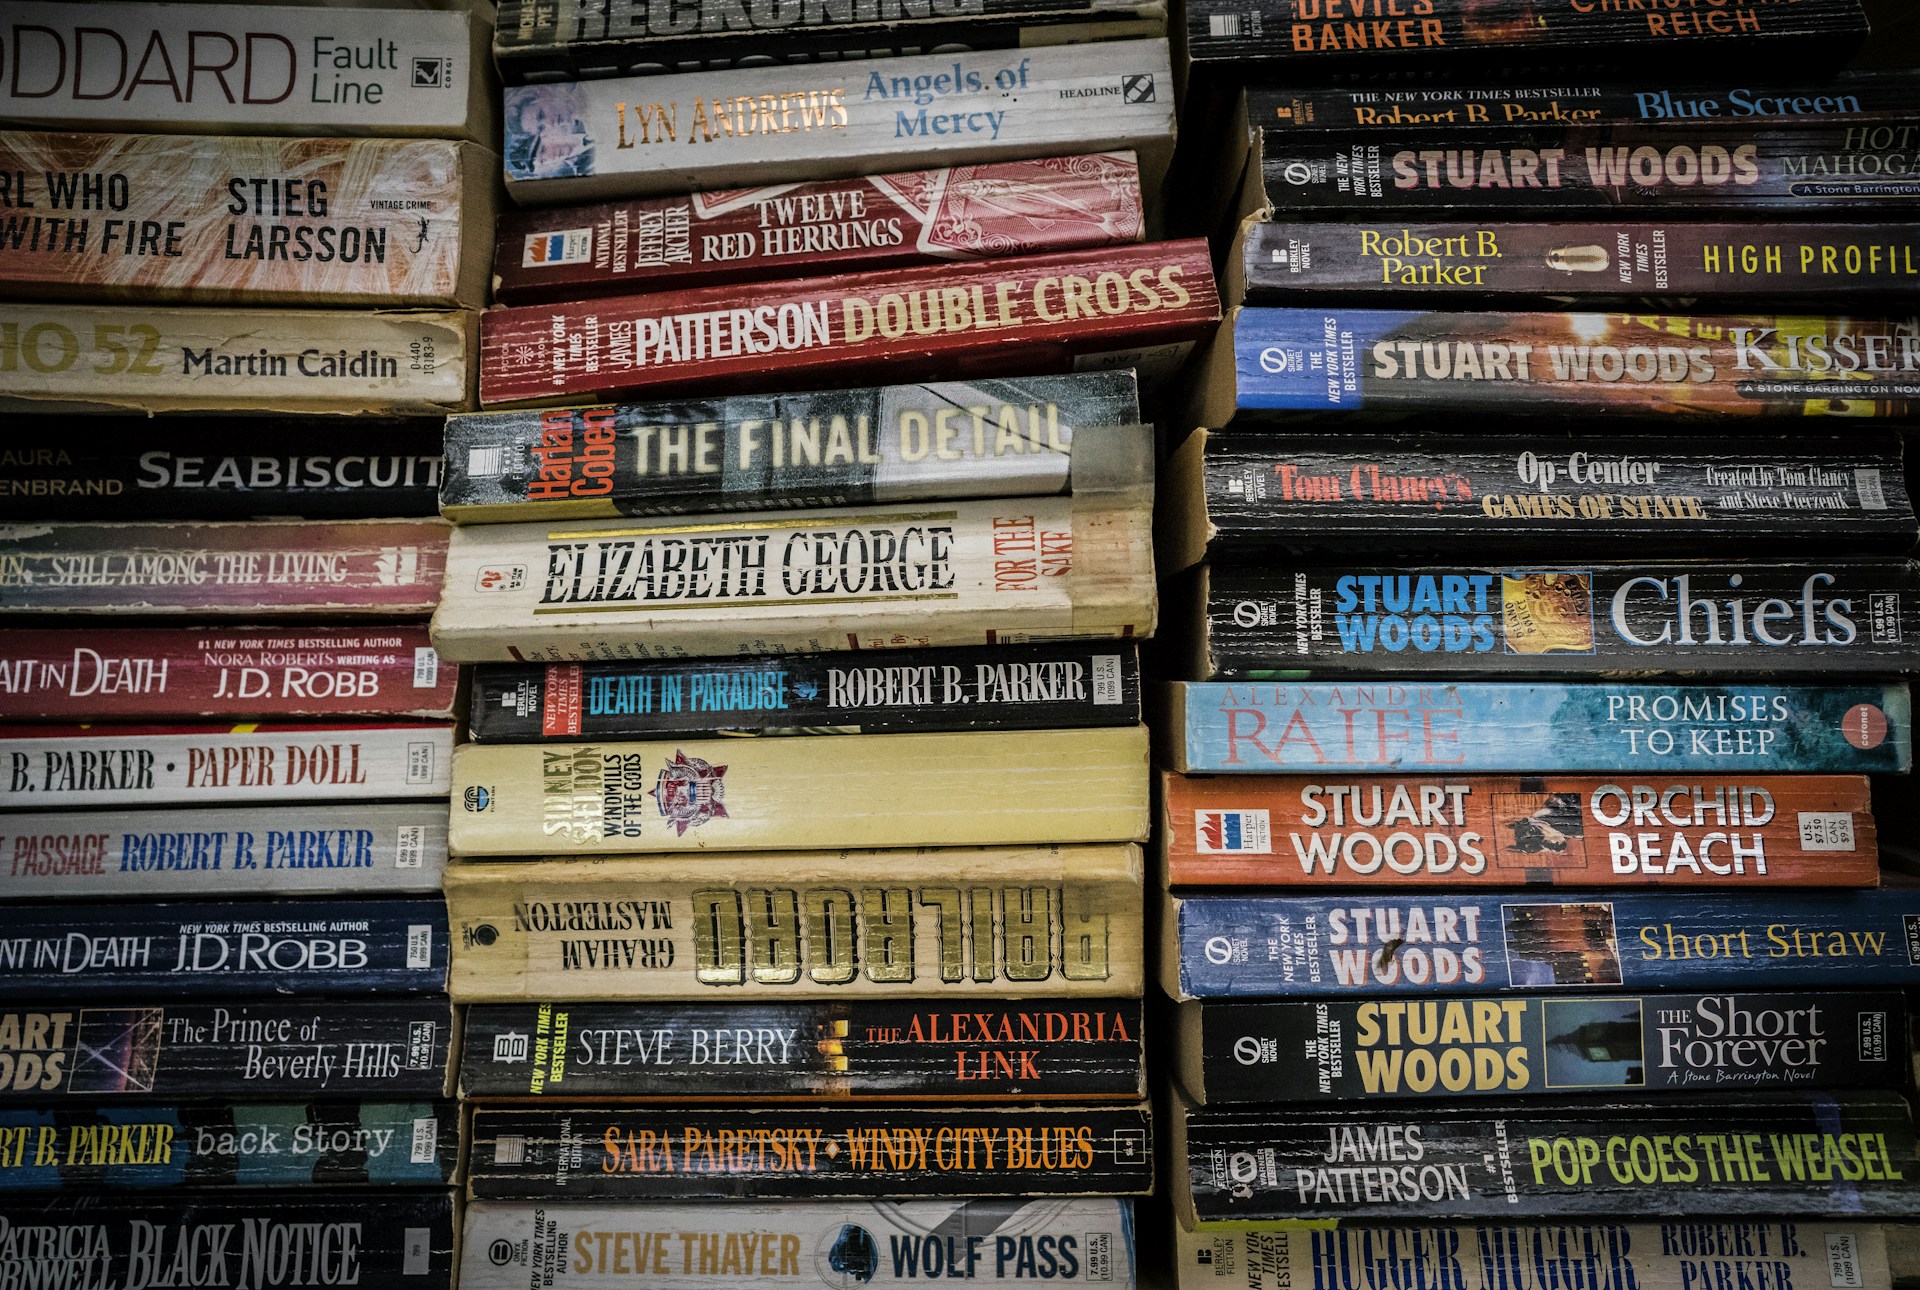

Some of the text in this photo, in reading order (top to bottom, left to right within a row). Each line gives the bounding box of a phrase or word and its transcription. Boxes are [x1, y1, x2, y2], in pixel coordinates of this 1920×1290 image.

[1292, 18, 1445, 52] BANKER
[1646, 10, 1761, 37] REICH
[312, 36, 398, 71] Fault
[311, 74, 384, 104] Line
[863, 58, 1031, 106] Angels of
[1059, 86, 1121, 99] HEADLINE
[1350, 87, 1602, 103] THE NEW YORK TIMES BESTSELLER
[616, 87, 849, 150] LYN ANDREWS
[894, 109, 1004, 140] Mercy
[1634, 88, 1862, 119] Blue Screen
[1392, 144, 1760, 190] STUART WOODS
[46, 172, 129, 212] WHO
[227, 178, 328, 217] STIEG
[370, 200, 431, 210] VINTAGE CRIME
[753, 189, 867, 229] TWELVE
[101, 220, 186, 257] FIRE
[225, 224, 387, 263] LARSSON
[635, 210, 670, 269] JEFFREY
[663, 204, 693, 264] ARCHER
[701, 217, 904, 263] RED HERRINGS
[1360, 230, 1502, 258] Robert B.
[1381, 257, 1487, 286] Parker
[1653, 230, 1668, 288] BESTSELLER
[635, 265, 1191, 366] PATTERSON DOUBLE CROSS
[181, 346, 397, 378] Martin Caidin
[585, 315, 598, 372] BESTSELLER
[609, 321, 631, 369] JAMES
[1341, 331, 1356, 390] BESTSELLER
[1372, 341, 1716, 383] STUART WOODS
[528, 411, 574, 499] Harlan
[571, 409, 616, 496] Coben
[631, 403, 1072, 476] THE FINAL DETAIL
[1276, 464, 1473, 510] Tom Clancy's
[1516, 450, 1661, 493] Op-Center
[1481, 494, 1709, 520] GAMES OF STATE
[539, 527, 956, 604] ELIZABETH GEORGE
[1310, 588, 1322, 640] BESTSELLER
[1336, 574, 1493, 613] STUART
[1609, 572, 1858, 648] Chiefs
[198, 637, 402, 649] #1 NEW YORK TIMES BESTSELLING AUTHOR
[1336, 614, 1496, 652] WOODS
[204, 652, 334, 667] NORA ROBERTS
[213, 667, 379, 699] J.D. ROBB
[589, 671, 788, 716] DEATH IN PARADISE
[826, 661, 1086, 708] ROBERT B. PARKER
[1219, 686, 1464, 707] ALEXANDRA
[1606, 695, 1788, 722] PROMISES
[1860, 706, 1869, 746] coronet
[1219, 708, 1466, 766] RAIFE
[1621, 729, 1775, 756] TO KEEP
[10, 744, 367, 792] B. PARKER PAPER DOLL
[603, 754, 623, 838] WINDMILLS
[1300, 785, 1471, 827] STUART
[1590, 784, 1776, 828] ORCHID
[118, 829, 374, 872] ROBERT B. PARKER
[1816, 819, 1824, 844] $7.50
[1289, 832, 1487, 875] WOODS
[1608, 832, 1768, 876] BEACH
[514, 901, 675, 932] MASTERTON
[692, 886, 1111, 989] RAILROAD
[1328, 906, 1482, 946] STUART
[171, 933, 368, 973] J.D. ROBB
[561, 937, 675, 970] GRAHAM
[1306, 915, 1321, 983] BESTSELLER
[1639, 923, 1886, 962] Short Straw
[168, 1008, 322, 1044] The Prince of
[866, 1012, 1130, 1044] THE ALEXANDRIA
[1356, 1000, 1526, 1046] STUART
[1657, 997, 1825, 1039] THE Short
[244, 1043, 400, 1087] Beverly Hills
[550, 1013, 568, 1082] BESTSELLER
[576, 1028, 798, 1066] STEVE BERRY
[955, 1050, 1041, 1081] LINK
[1329, 1020, 1342, 1077] BESTSELLER
[1656, 1027, 1827, 1069] Forever
[1354, 1048, 1530, 1094] WOODS
[1667, 1068, 1816, 1085] A Stone Barrington Novel
[35, 1124, 394, 1167] B. PARKER back Story
[602, 1126, 1093, 1174] SARA PARETSKY WINDY CITY BLUES
[1324, 1125, 1424, 1164] JAMES
[1494, 1119, 1519, 1204] BESTSELLER
[1527, 1132, 1903, 1186] POP GOES THE WEASEL
[1295, 1164, 1471, 1204] PATTERSON
[128, 1218, 362, 1289] BLACK NOTICE
[543, 1221, 556, 1286] BESTSELLING
[557, 1233, 568, 1273] AUTHOR
[573, 1231, 801, 1276] STEVE THAYER
[889, 1234, 1079, 1279] WOLF PASS
